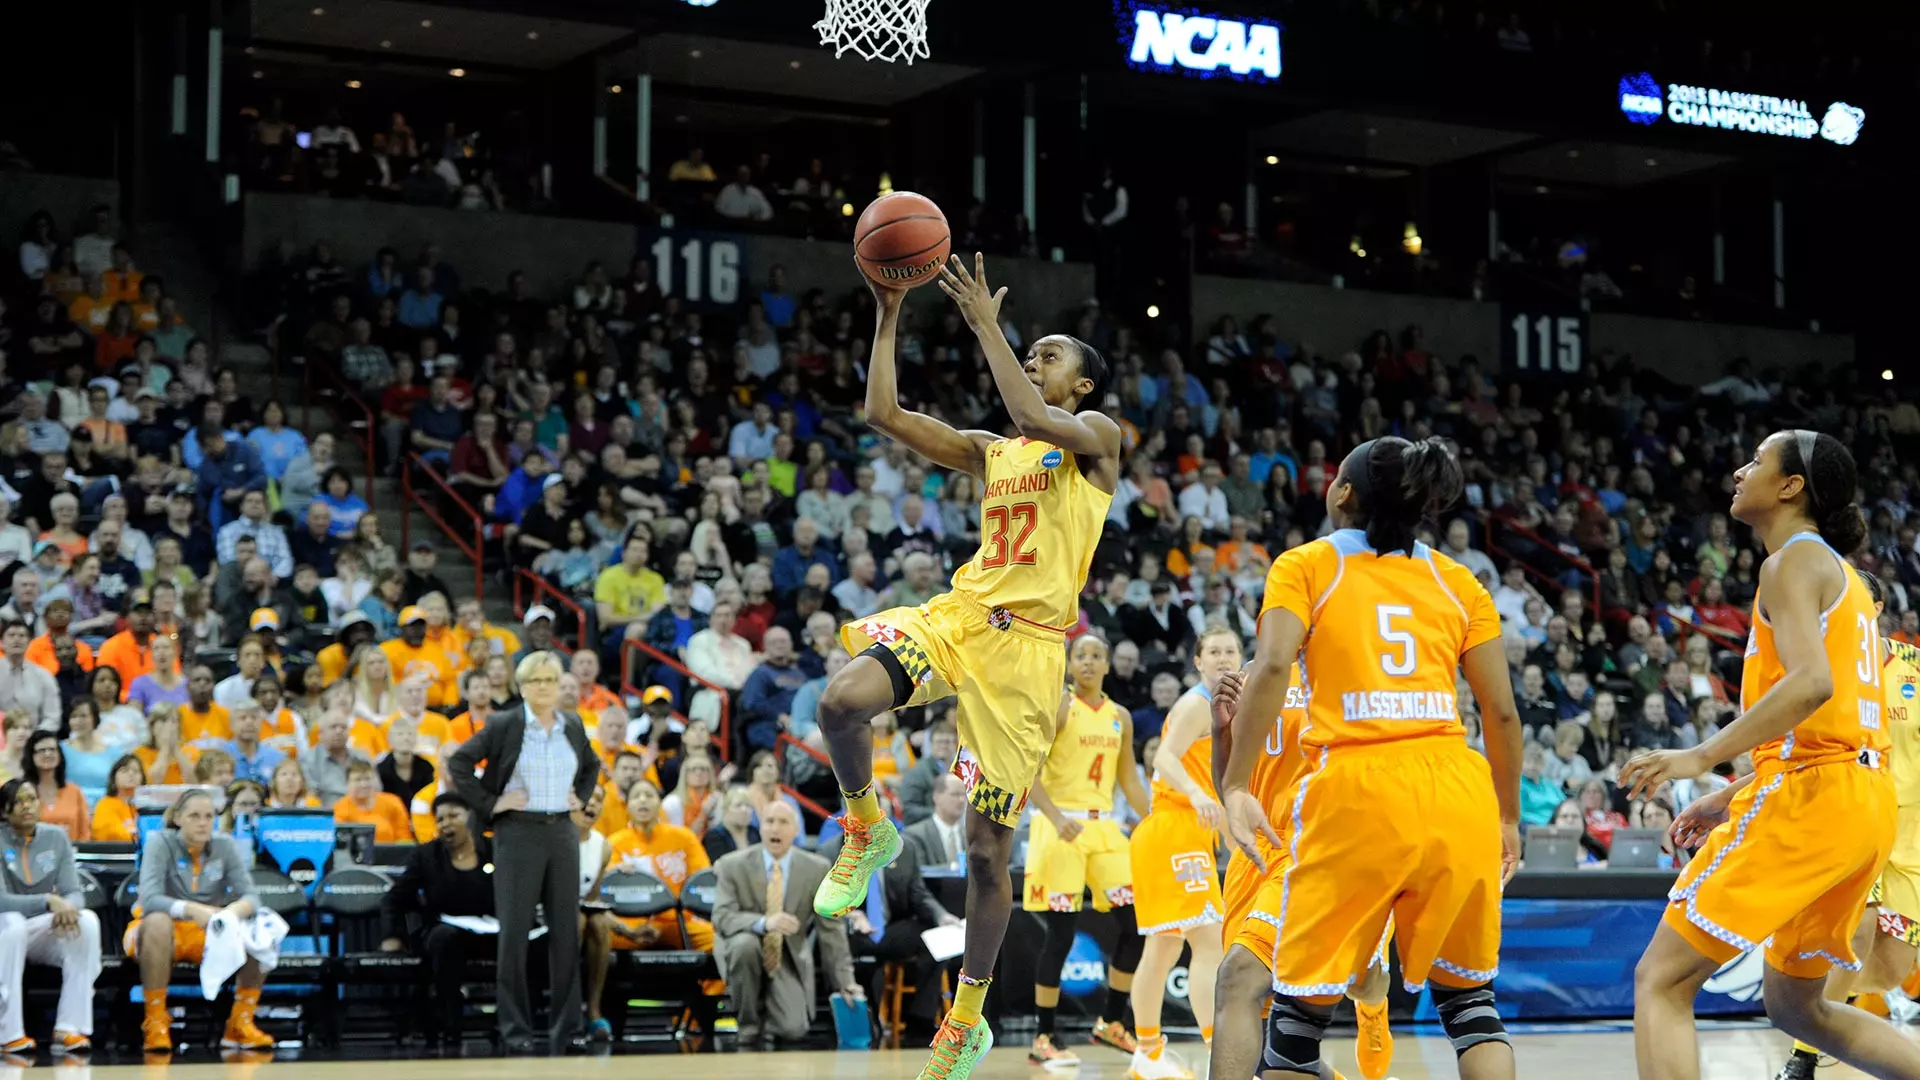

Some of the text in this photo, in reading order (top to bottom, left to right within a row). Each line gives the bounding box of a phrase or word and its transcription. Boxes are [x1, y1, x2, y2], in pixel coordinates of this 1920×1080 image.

[1130, 10, 1282, 78] NCAA
[1667, 83, 1812, 118] 2015 BASKETBALL
[1667, 102, 1819, 139] CHAMPIONSHIP
[651, 236, 740, 304] 116
[878, 255, 941, 280] Wilson
[1511, 313, 1581, 373] 115
[981, 501, 1038, 571] 32
[1376, 603, 1417, 677] 5
[1342, 689, 1457, 722] MASSENGALE
[1088, 752, 1105, 790] 4
[1030, 885, 1044, 903] M
[1060, 961, 1106, 982] NCAA
